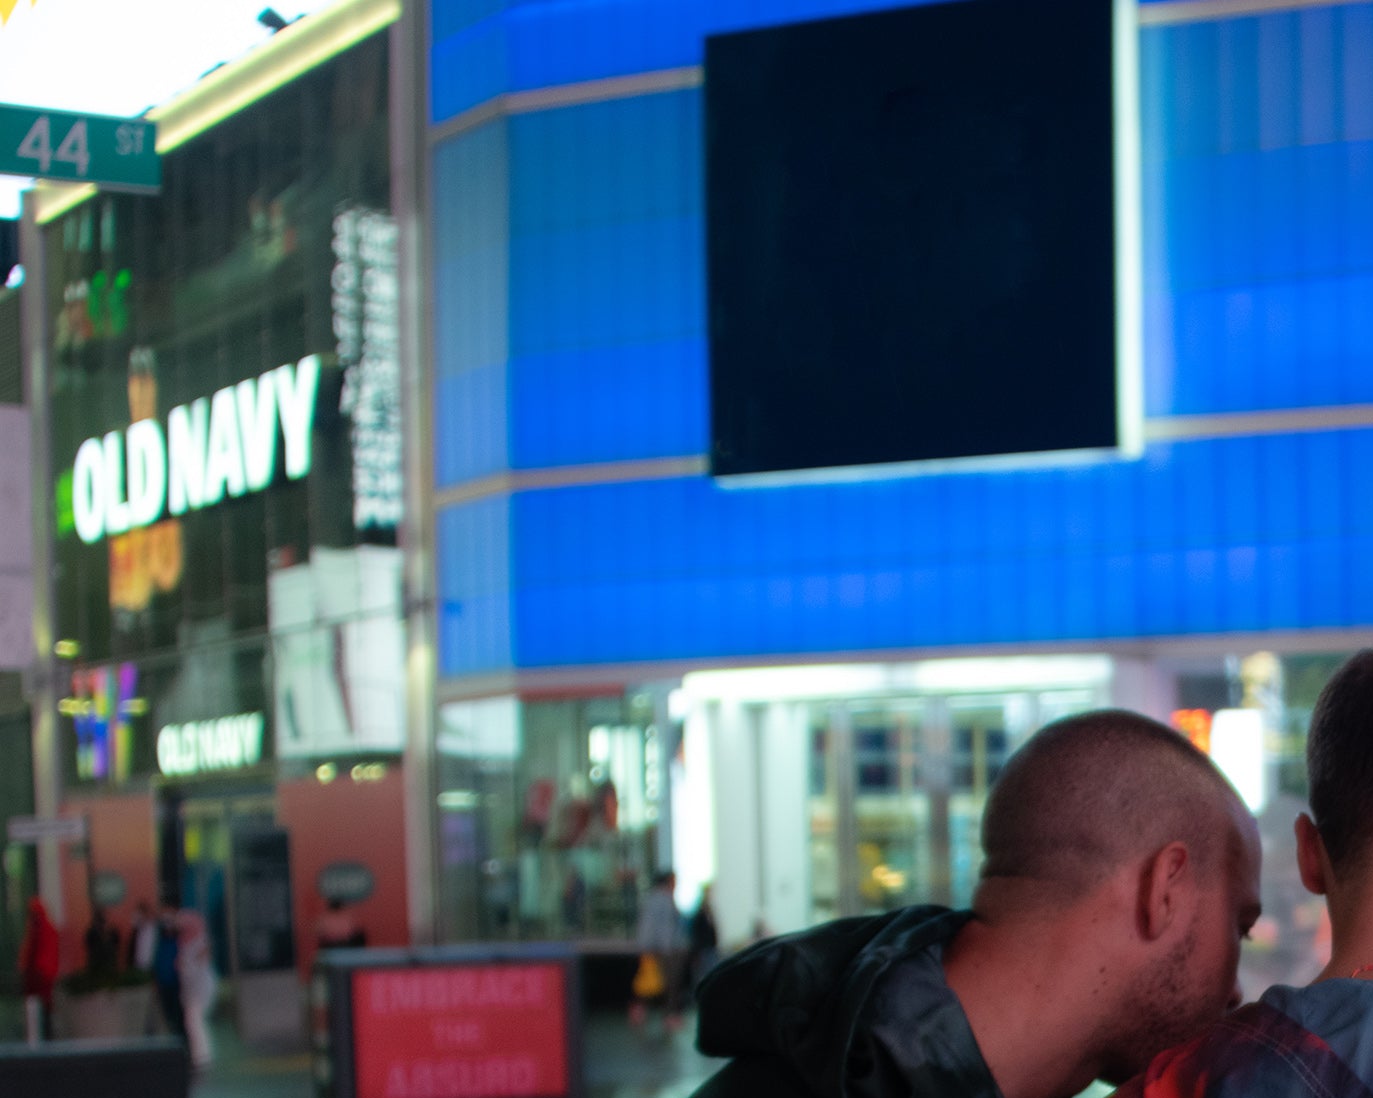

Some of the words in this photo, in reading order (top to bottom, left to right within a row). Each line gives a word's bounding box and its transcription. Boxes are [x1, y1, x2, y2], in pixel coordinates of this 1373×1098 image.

[17, 115, 90, 176] 44
[115, 124, 145, 156] ST
[72, 418, 167, 545] OLD
[168, 353, 322, 516] NAVY
[157, 722, 196, 777] OLD
[197, 711, 264, 774] NAVY
